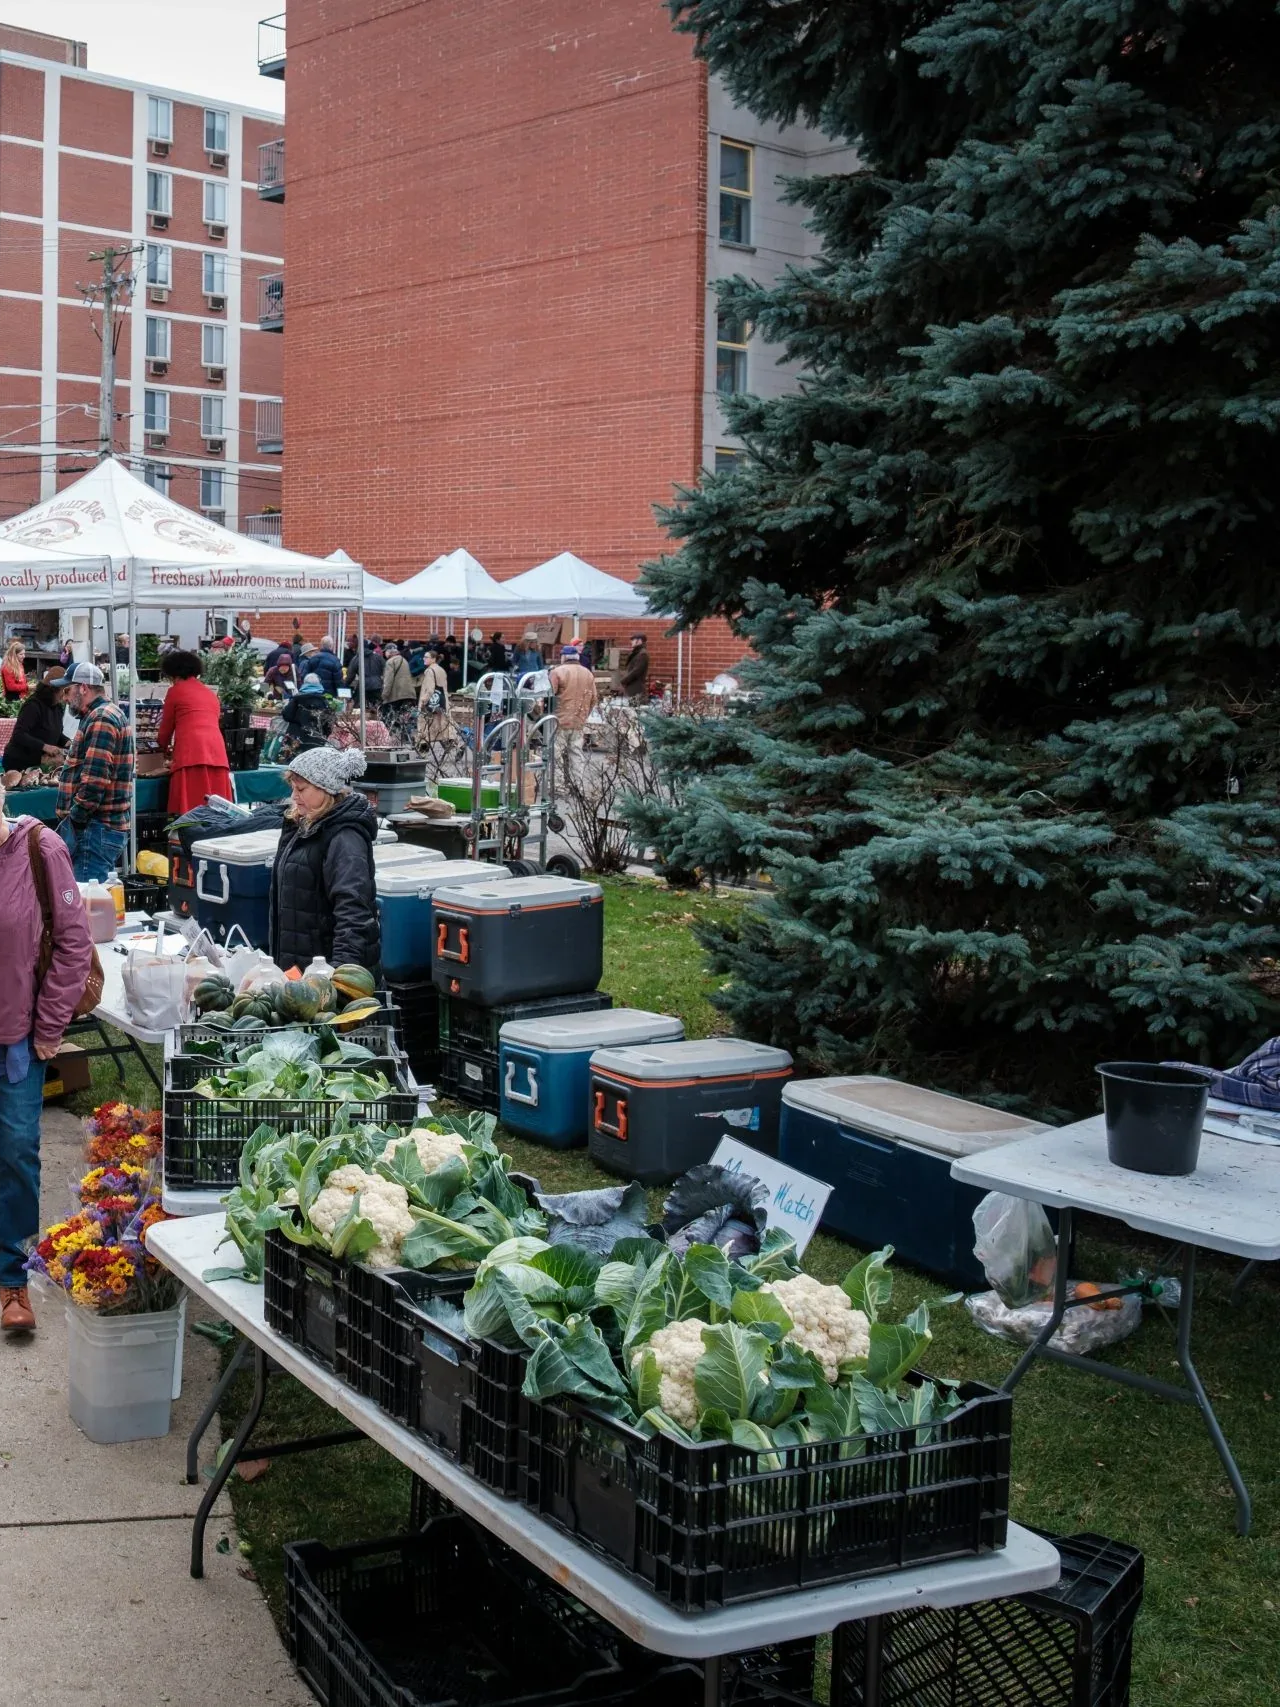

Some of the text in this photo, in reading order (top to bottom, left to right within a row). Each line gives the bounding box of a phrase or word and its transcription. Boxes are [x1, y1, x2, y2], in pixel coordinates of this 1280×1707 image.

[45, 565, 107, 591] produced
[152, 566, 205, 586] Freshest
[208, 568, 281, 588] Mushrooms
[284, 571, 306, 589] and
[223, 590, 294, 603] www.rvrvalley.com
[773, 1181, 816, 1226] Match
